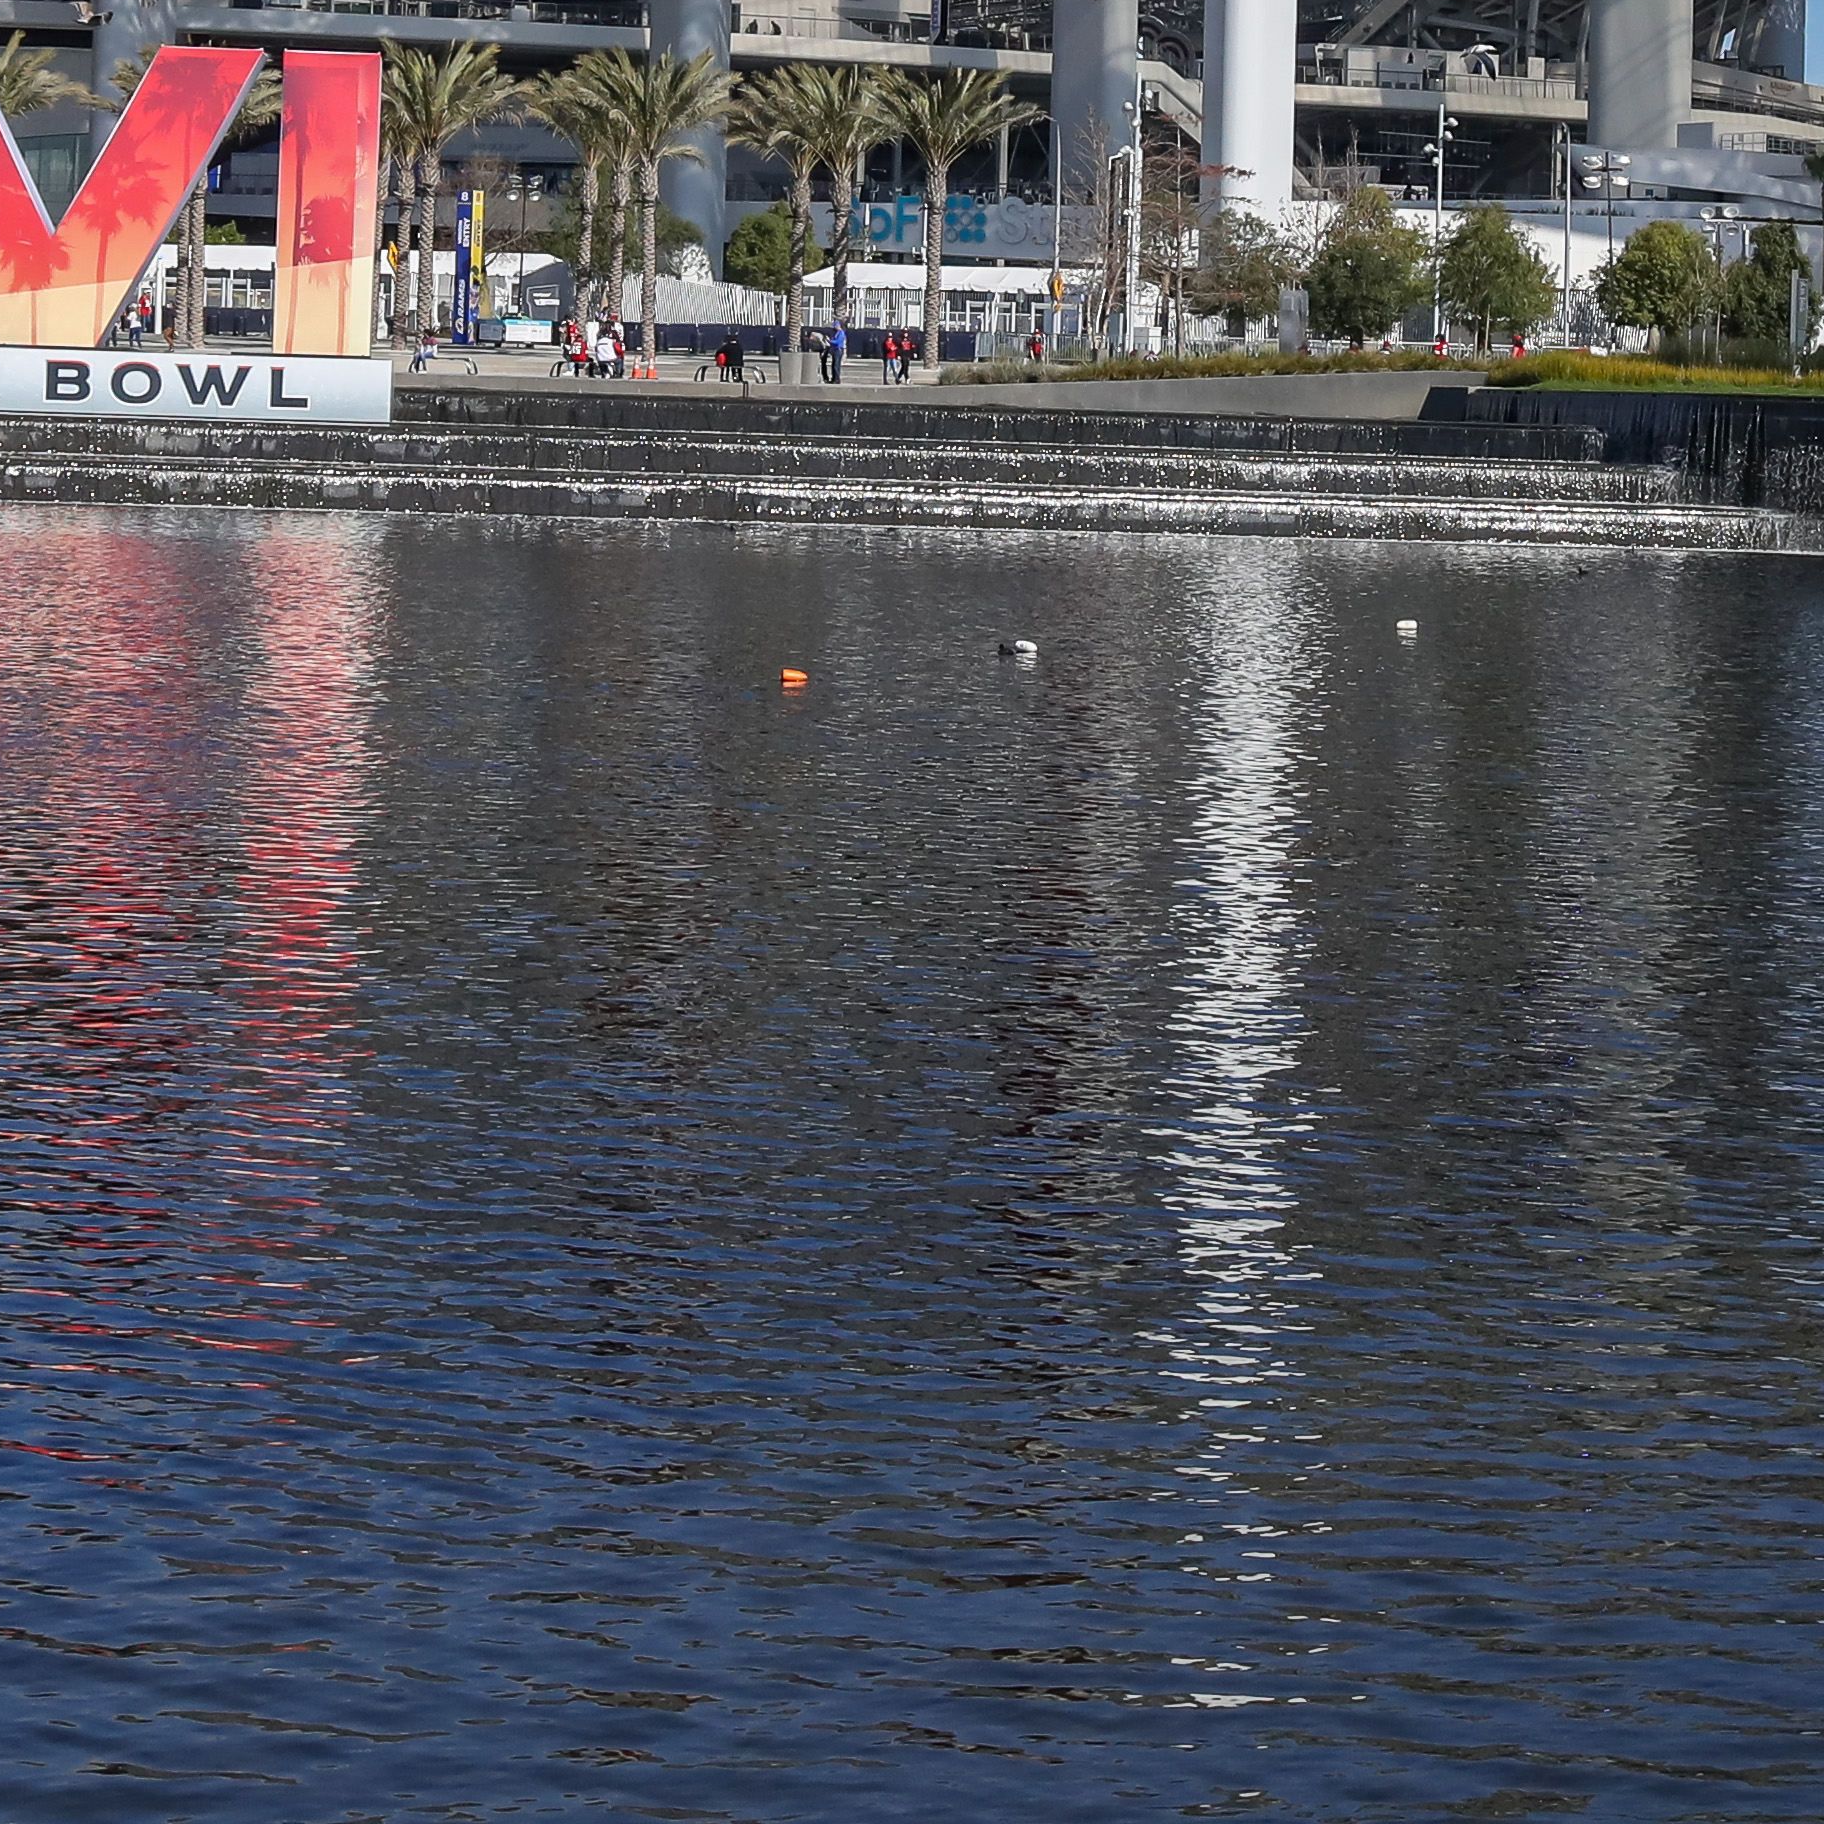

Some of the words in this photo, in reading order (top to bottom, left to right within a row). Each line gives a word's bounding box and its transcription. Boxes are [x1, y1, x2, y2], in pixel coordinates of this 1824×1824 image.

[461, 192, 469, 201] 8
[462, 218, 470, 247] ENTRY
[458, 279, 466, 317] RAMS
[44, 359, 310, 409] BOWL
